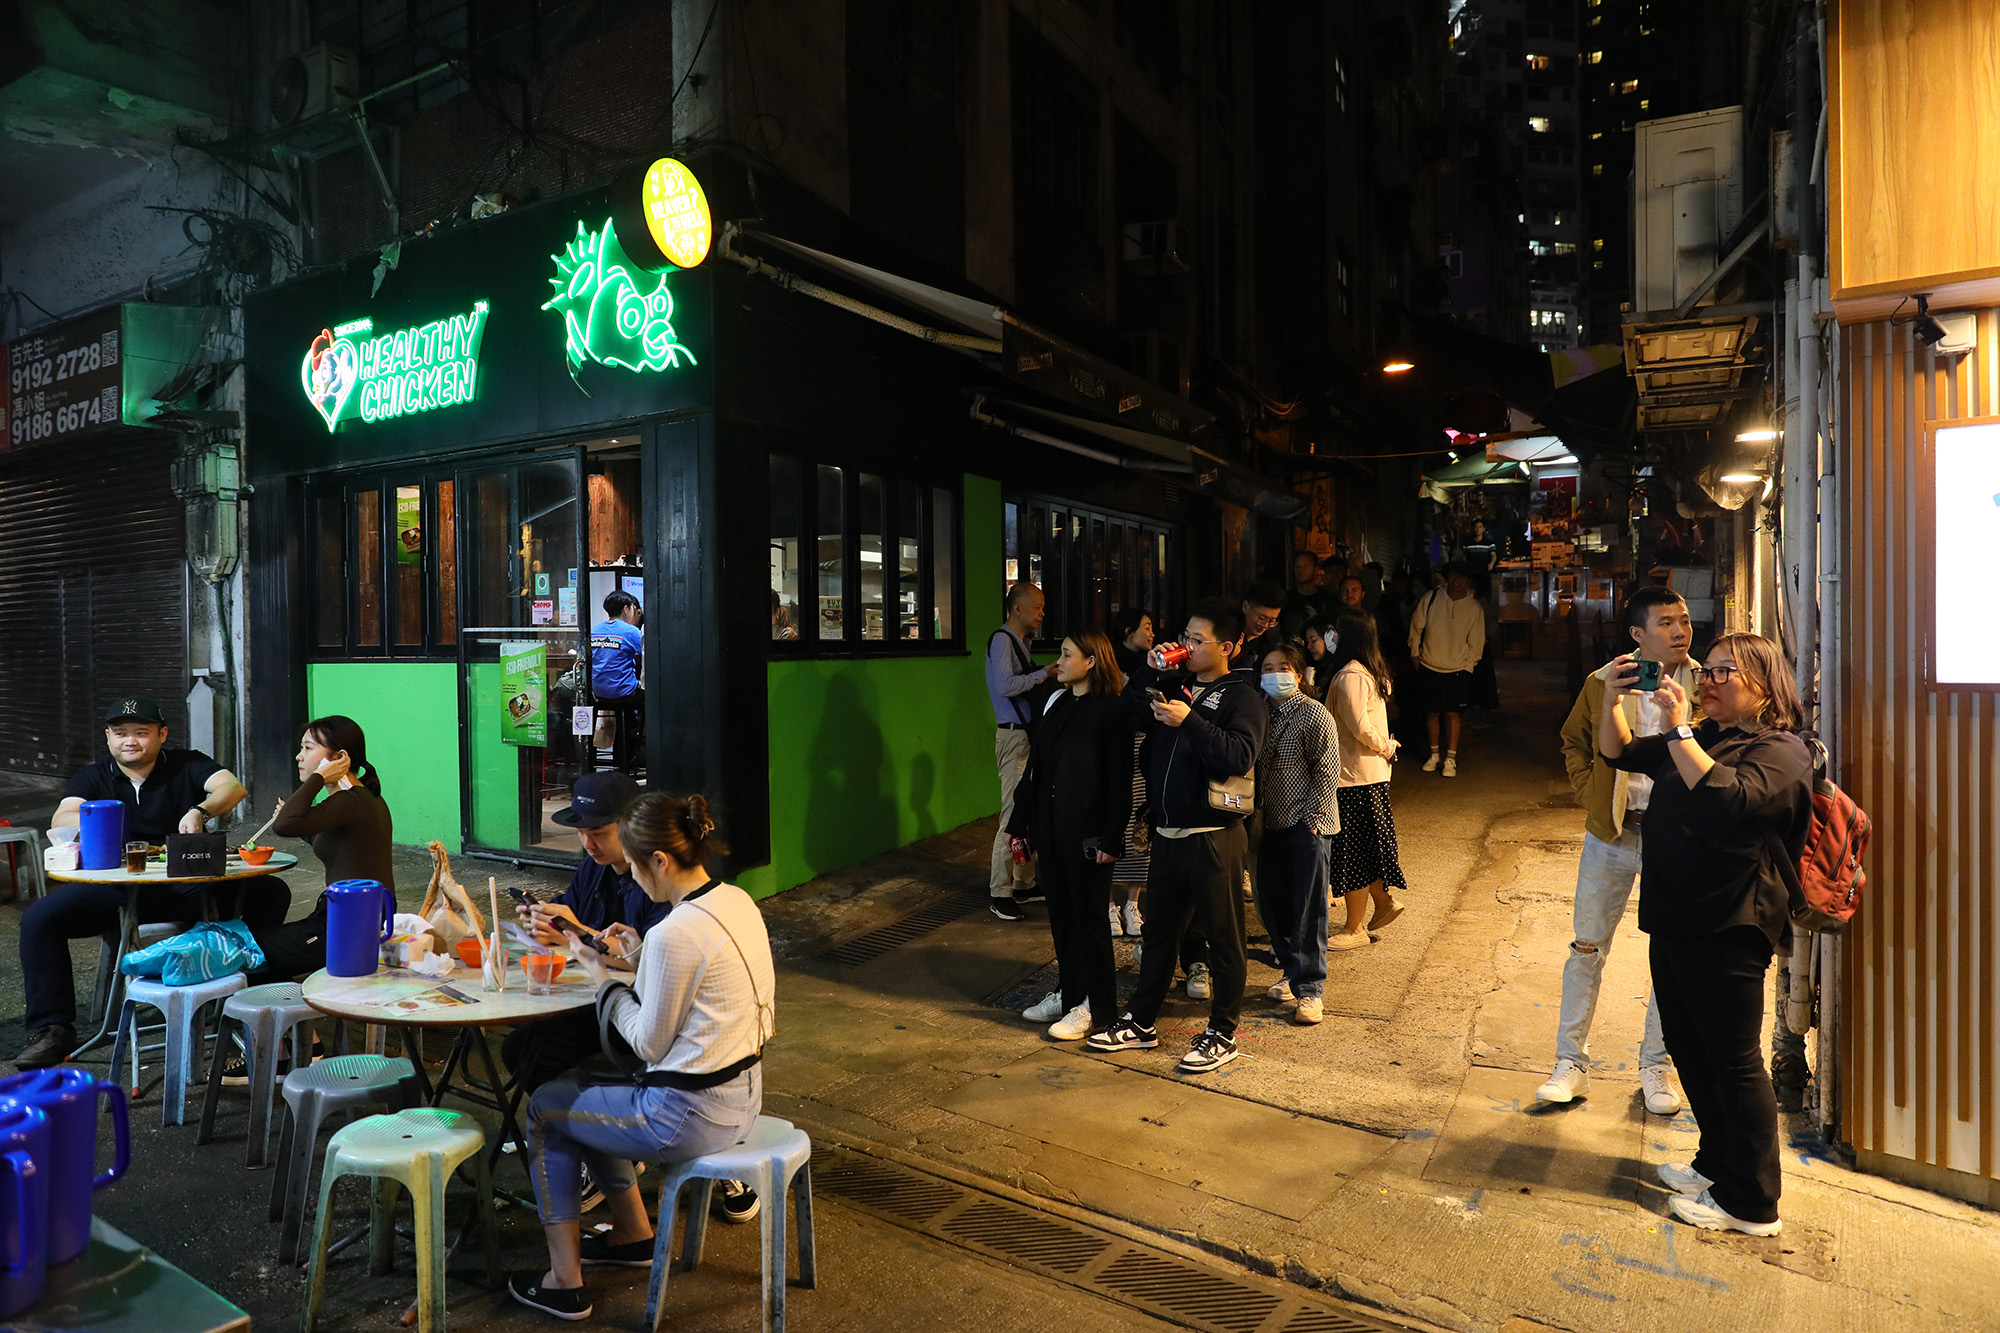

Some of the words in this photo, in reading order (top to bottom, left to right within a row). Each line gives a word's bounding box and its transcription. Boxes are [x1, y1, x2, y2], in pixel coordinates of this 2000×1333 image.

[650, 187, 698, 220] HEAVEN?
[680, 209, 706, 231] HELL
[11, 337, 45, 366] 古先生
[359, 312, 478, 380] HEALTHY
[12, 358, 53, 394] 9192
[56, 343, 101, 381] 2728
[12, 391, 45, 419] 馮小姐
[360, 358, 476, 424] CHICKEN
[12, 411, 53, 445] 9186
[56, 396, 101, 434] 6674
[506, 652, 542, 676] ECO-FRIENDLY
